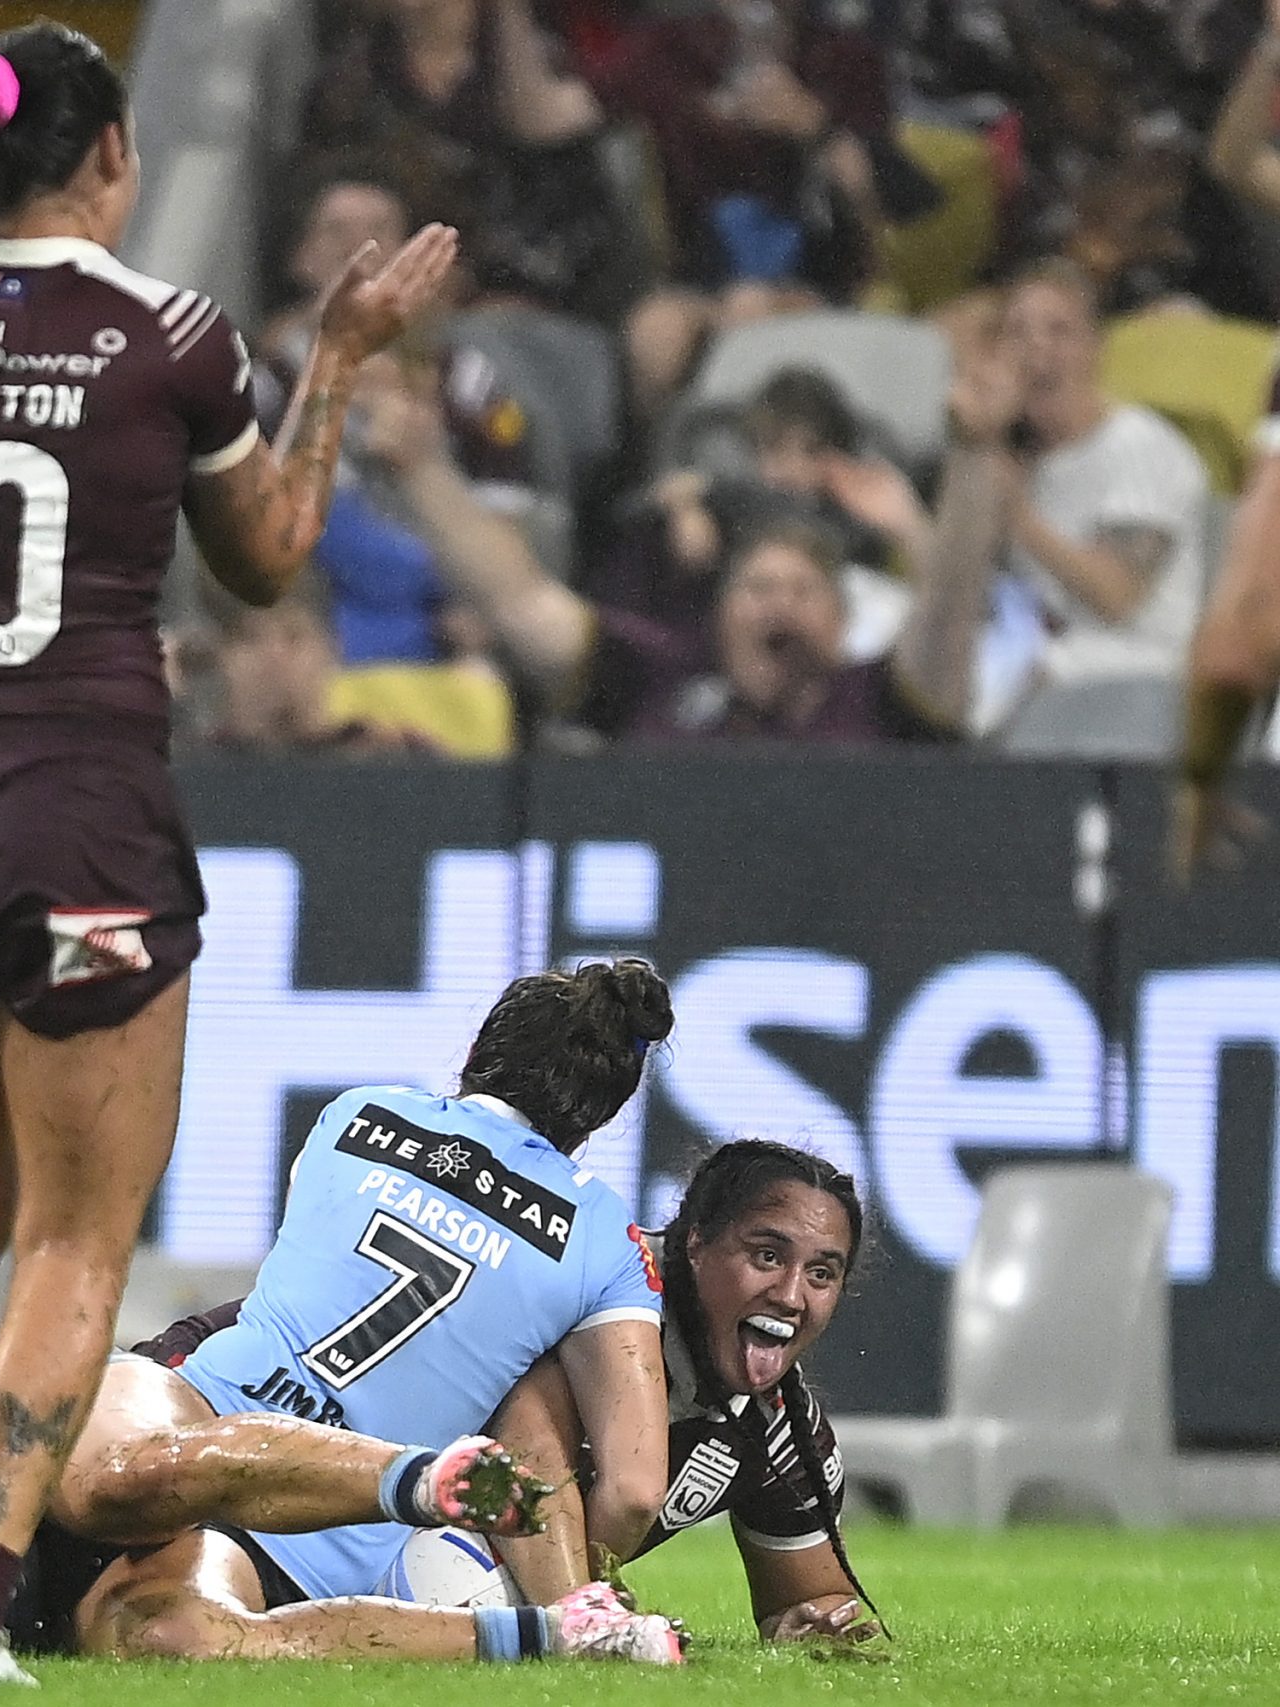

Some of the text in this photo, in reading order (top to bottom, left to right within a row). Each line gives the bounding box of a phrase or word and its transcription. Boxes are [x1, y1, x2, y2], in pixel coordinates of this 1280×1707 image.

[349, 1117, 571, 1243] THE STAR
[356, 1169, 512, 1270] PEARSON
[301, 1208, 478, 1391] 7
[240, 1366, 318, 1419] JIM
